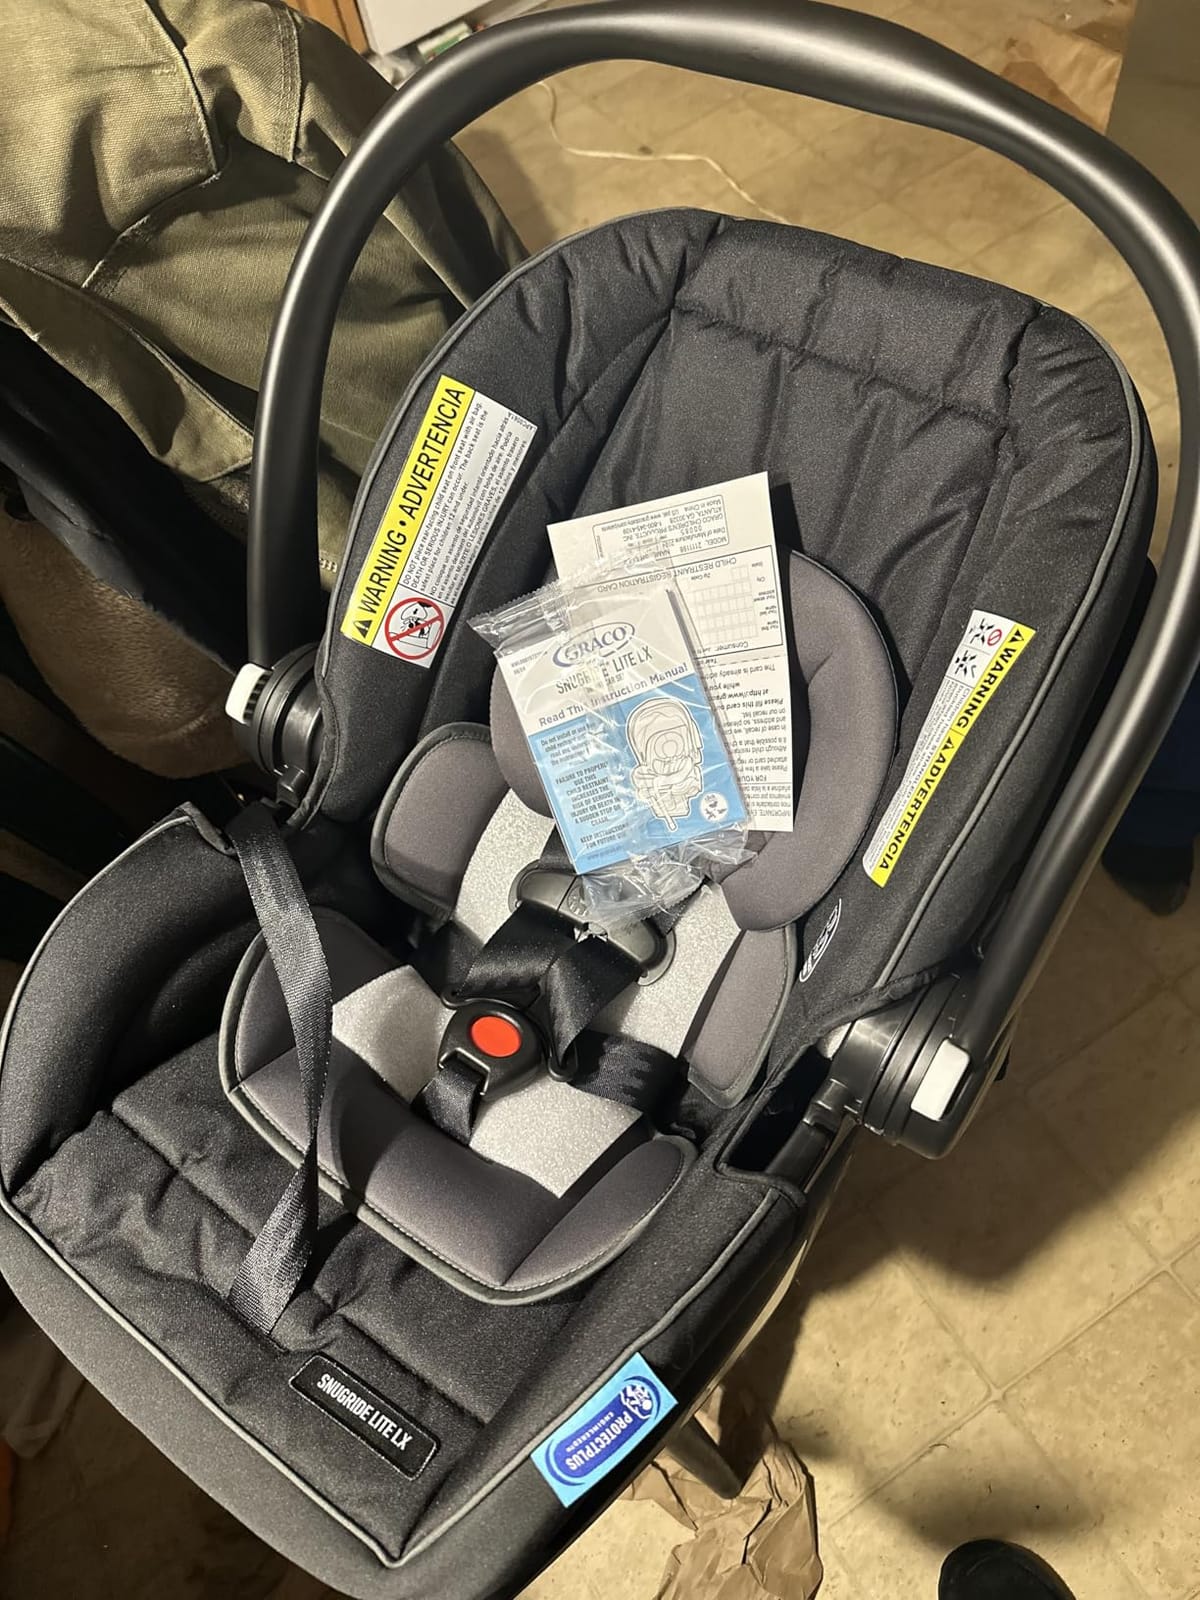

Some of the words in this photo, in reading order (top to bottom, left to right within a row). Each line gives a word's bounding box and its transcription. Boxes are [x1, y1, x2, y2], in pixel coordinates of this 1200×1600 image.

[467, 415, 477, 426] air
[479, 410, 489, 422] the
[461, 424, 473, 440] with
[471, 427, 482, 443] seat
[456, 438, 467, 454] seat
[464, 442, 476, 458] back
[449, 453, 461, 470] front
[459, 458, 469, 471] The
[445, 469, 455, 479] on
[439, 478, 451, 493] seat
[358, 530, 407, 612] WARNING
[399, 387, 466, 519] ADVERTENCIA
[433, 492, 445, 510] child
[445, 490, 455, 504] can
[451, 500, 461, 514] and
[435, 503, 450, 528] INJURY
[447, 512, 456, 521] 12
[419, 509, 438, 543] rear-facing
[437, 520, 453, 547] children
[423, 526, 440, 556] SERIOUS
[412, 542, 424, 560] place
[433, 546, 442, 556] for
[406, 559, 417, 574] NOT
[419, 555, 428, 567] OR
[425, 556, 437, 573] place
[671, 560, 714, 578] RESTRAINT
[713, 555, 737, 568] CHILD
[401, 573, 411, 585] DO
[410, 566, 424, 588] DEATH
[418, 570, 431, 591] safest
[618, 569, 671, 591] REGISTRATION
[596, 581, 618, 595] CARD
[562, 624, 629, 662] GRACO
[611, 651, 637, 672] LITE
[635, 645, 652, 663] LX
[749, 665, 762, 673] card
[764, 663, 775, 672] The
[955, 644, 1016, 730] WARNING
[725, 702, 740, 710] card
[537, 709, 566, 726] Read
[878, 751, 950, 873] ADVERTENCIA
[315, 1371, 375, 1421] SNUGRIDE
[366, 1409, 398, 1438] LITE
[389, 1426, 413, 1451] LX
[564, 1410, 633, 1471] PROTECTPLUS
